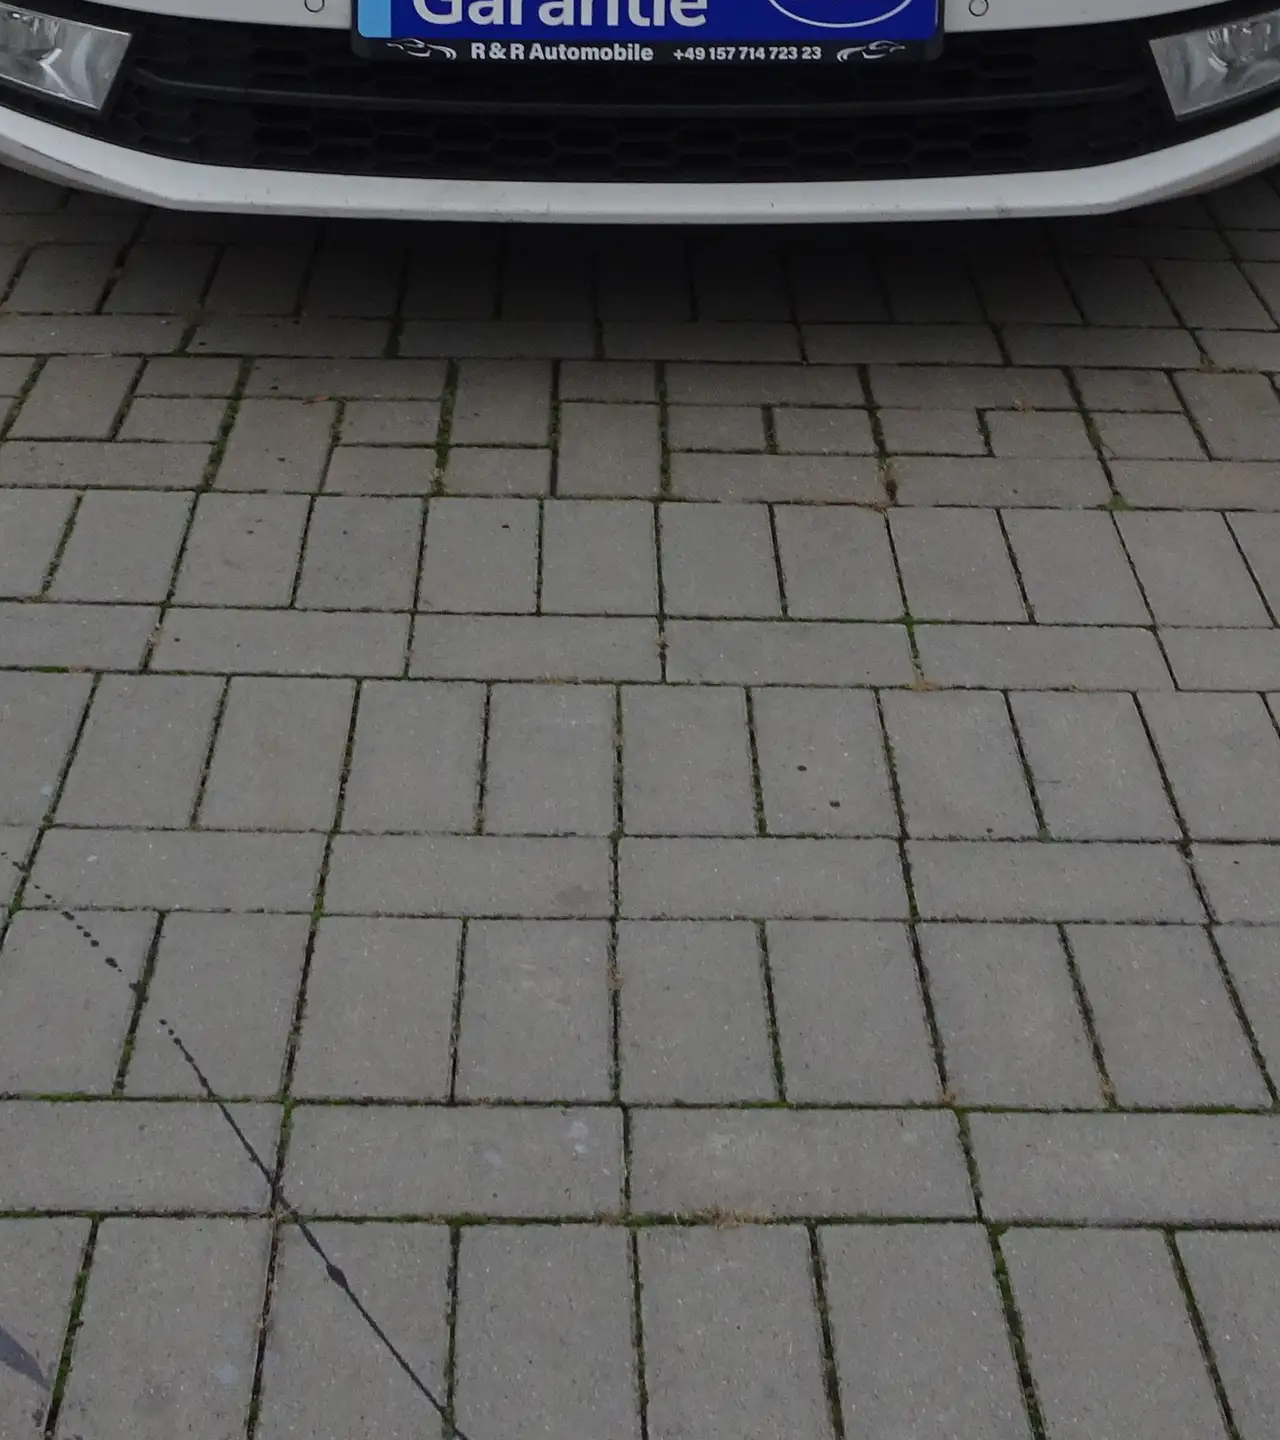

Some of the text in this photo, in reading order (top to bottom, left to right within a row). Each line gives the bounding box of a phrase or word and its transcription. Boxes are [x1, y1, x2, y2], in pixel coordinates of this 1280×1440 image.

[471, 42, 821, 61] R & R Automobile +49 157 714 723 23
